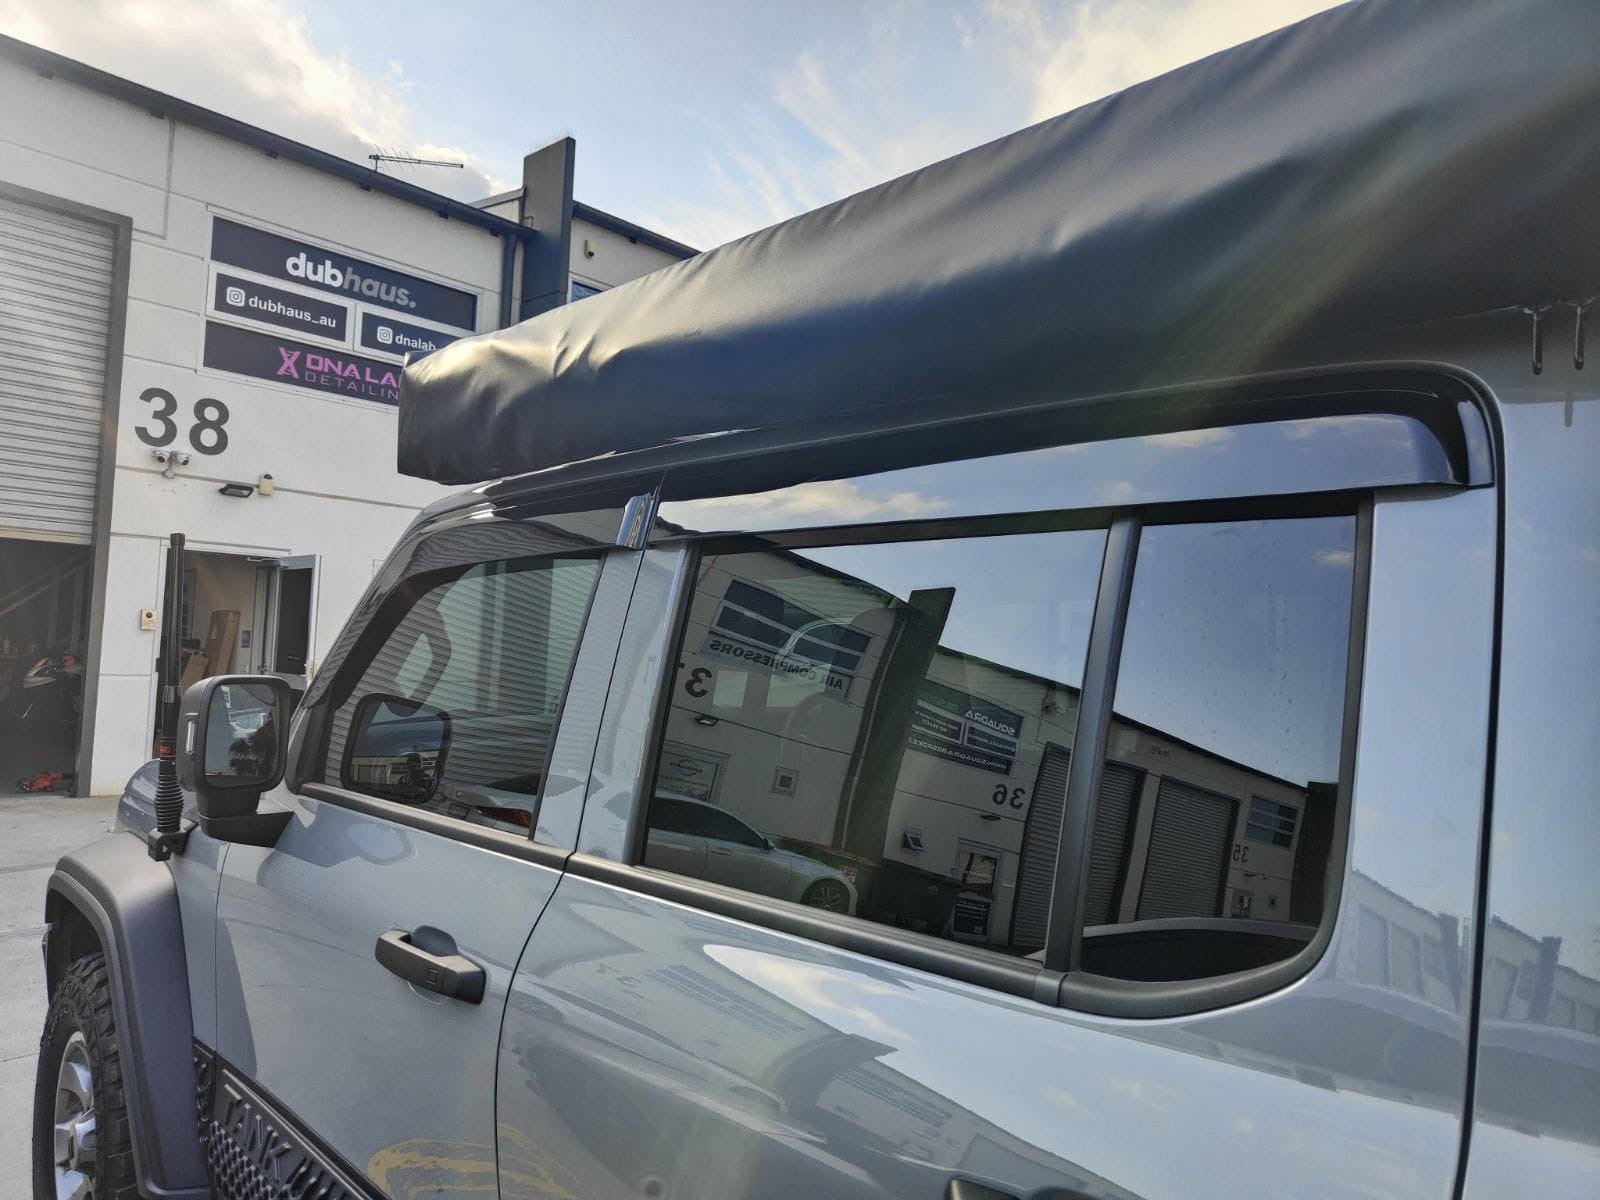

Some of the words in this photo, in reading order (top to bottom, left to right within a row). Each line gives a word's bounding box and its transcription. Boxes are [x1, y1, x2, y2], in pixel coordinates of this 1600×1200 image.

[286, 252, 417, 309] dubhaus.
[248, 296, 337, 329] dubhaus_au
[305, 353, 361, 380] DNA
[365, 367, 401, 389] LA
[134, 387, 230, 456] 38
